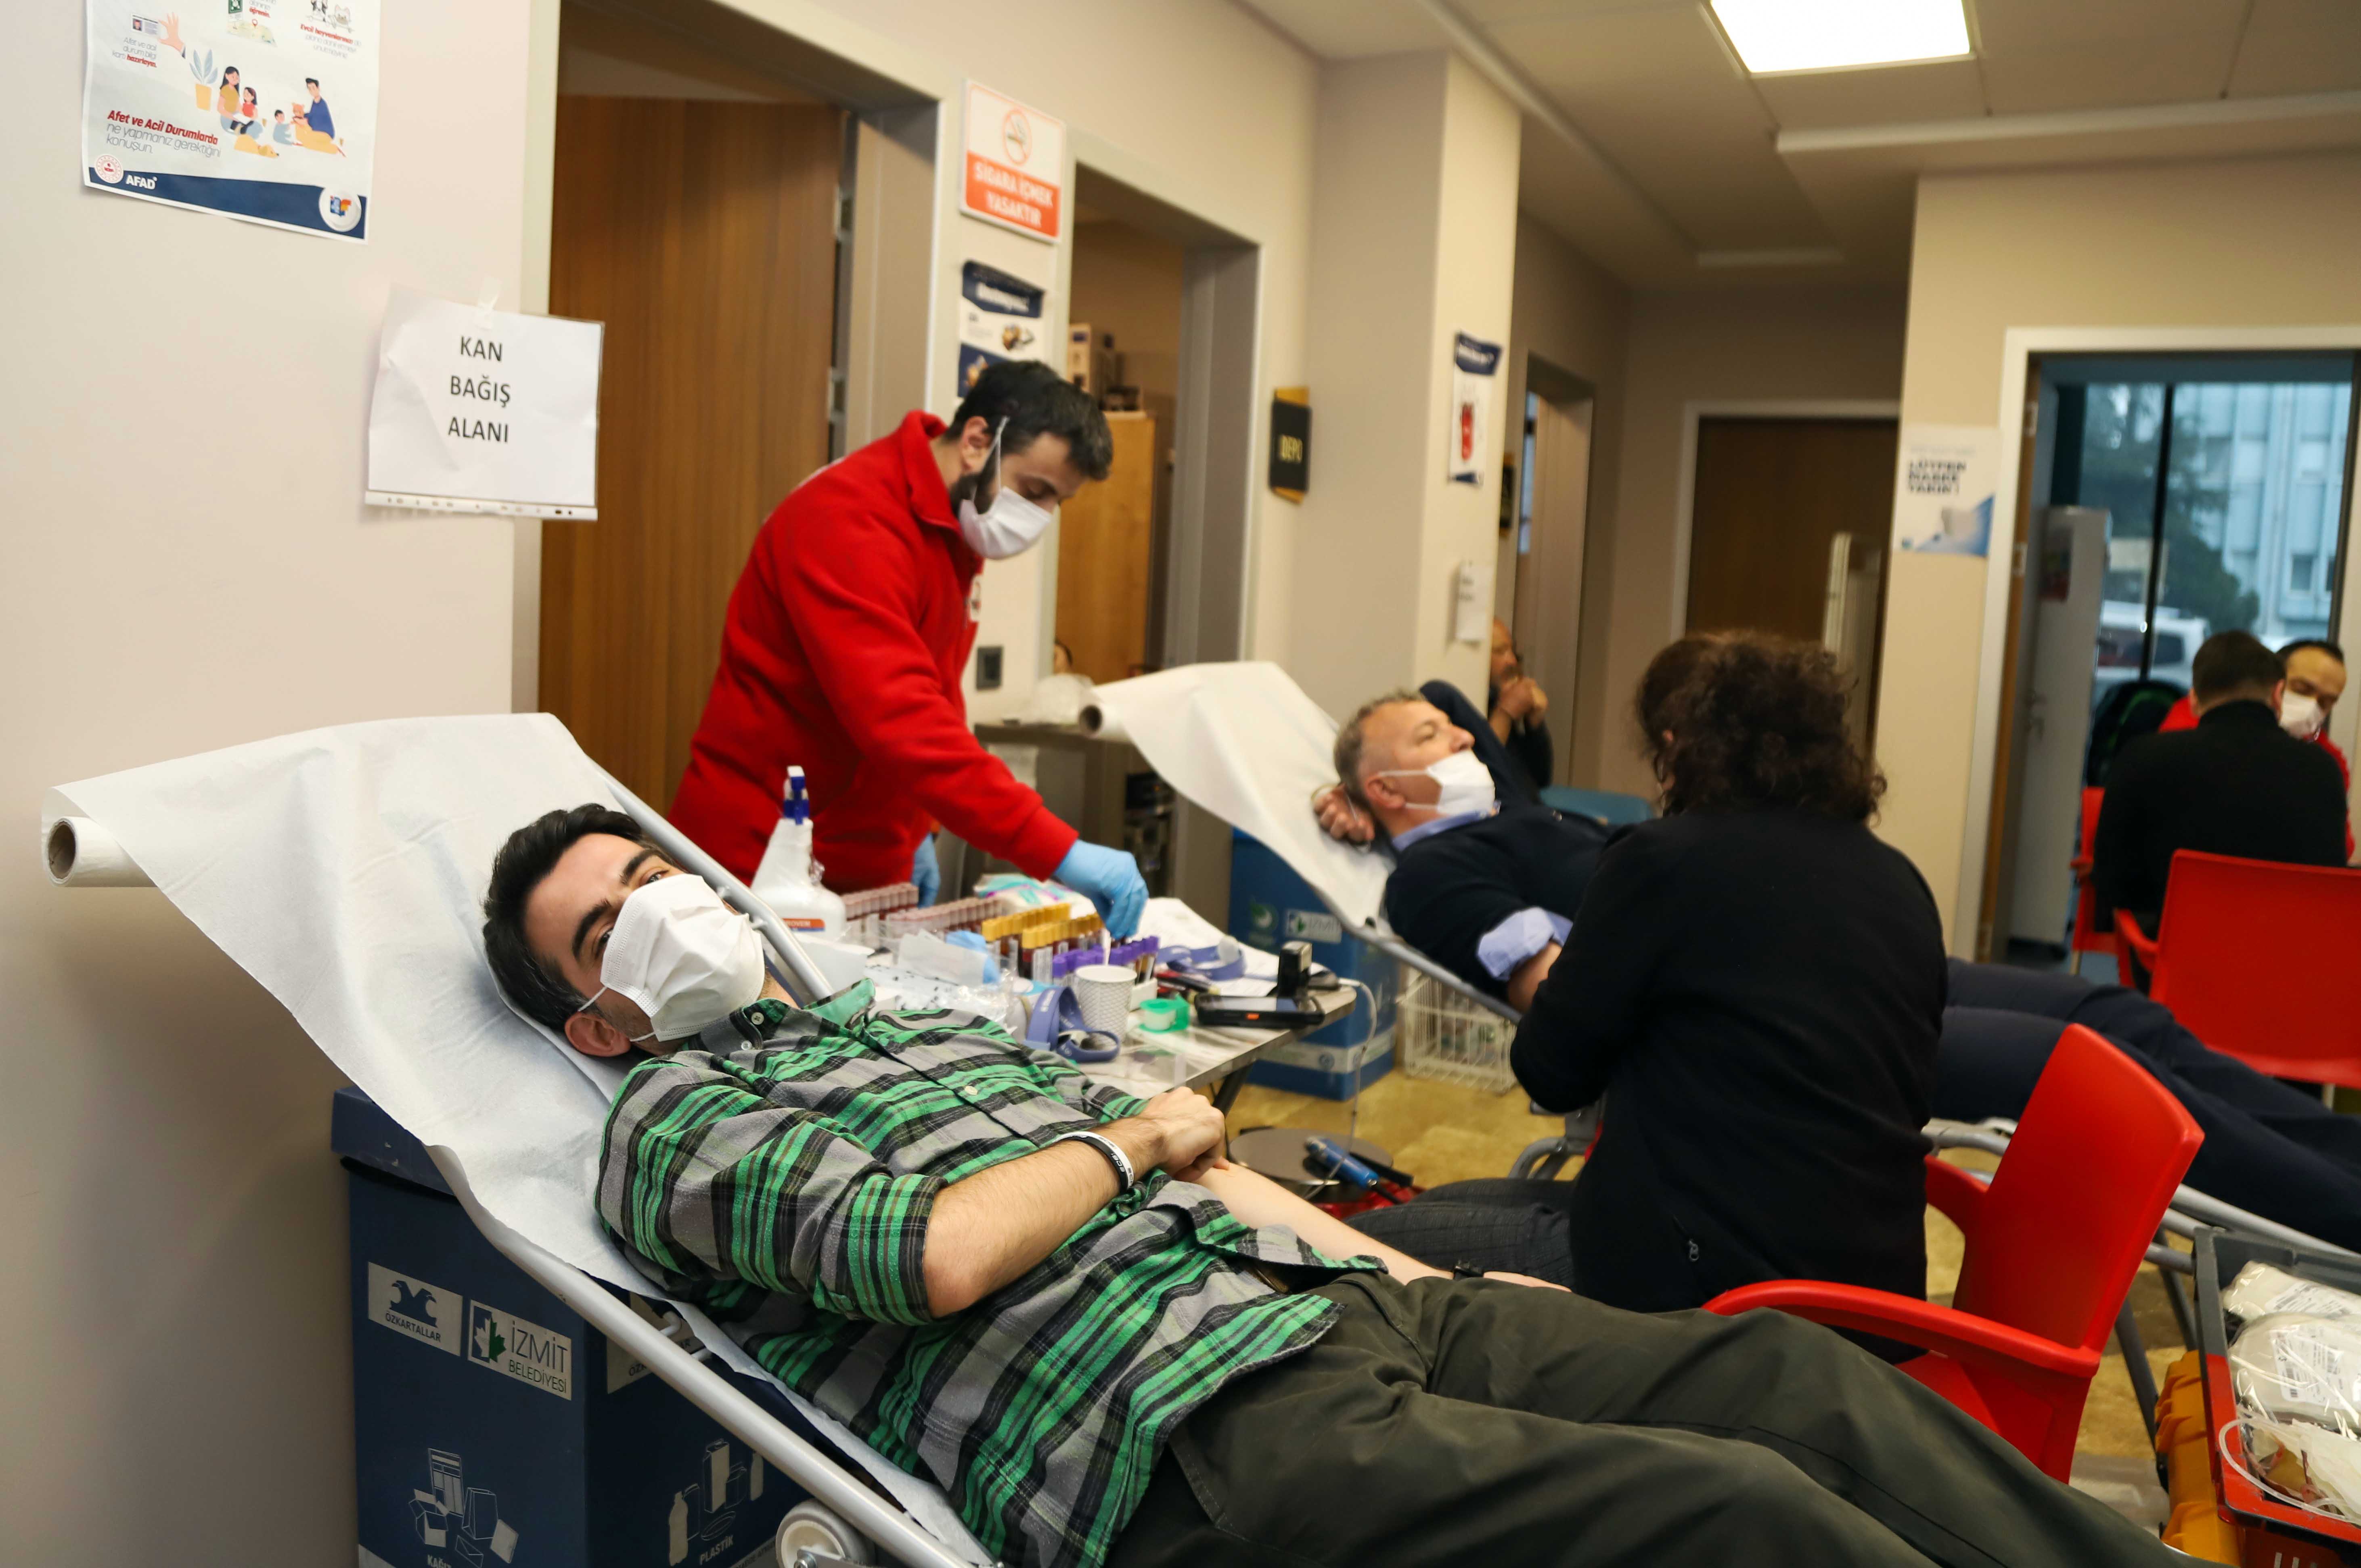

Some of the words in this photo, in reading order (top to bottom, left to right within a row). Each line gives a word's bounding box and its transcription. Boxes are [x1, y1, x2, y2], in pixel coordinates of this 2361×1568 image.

[123, 37, 136, 46] Afet
[107, 123, 121, 134] ne
[123, 127, 173, 146] yapmanız
[174, 140, 221, 157] gerektiğini
[108, 110, 130, 123] Afet
[132, 117, 143, 127] ve
[144, 119, 163, 131] Acil
[165, 124, 218, 144] Durumlarda
[106, 134, 153, 154] konuşun.
[126, 174, 156, 190] AFAD
[985, 189, 1042, 228] YASAKTIR
[460, 335, 503, 362] KAN
[450, 374, 511, 408] BAĞIŞ
[448, 416, 509, 443] ALANI
[385, 1311, 441, 1343] ÖZKARTALLAR
[511, 1320, 568, 1373] İZMİT
[509, 1359, 567, 1394] BELEDİYESİ
